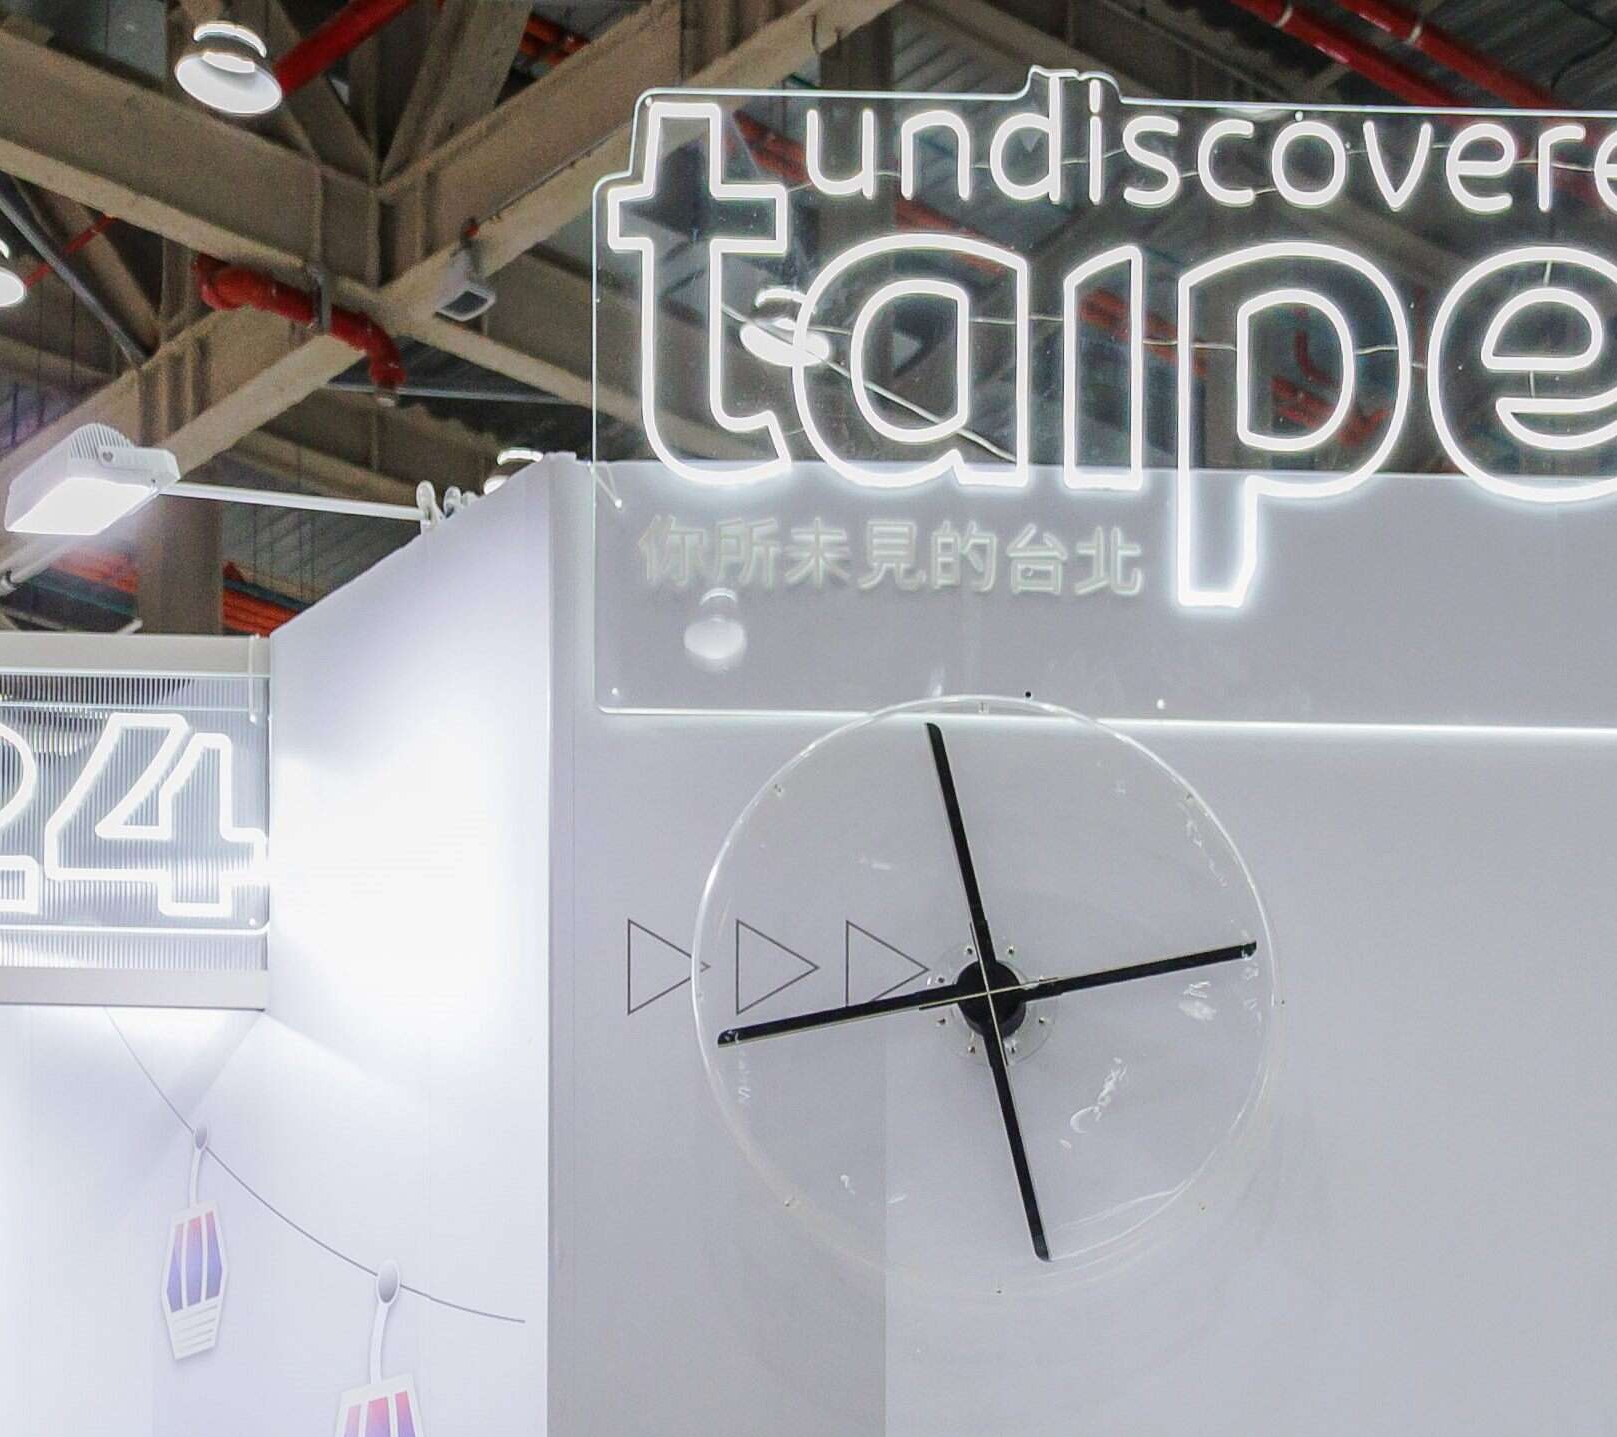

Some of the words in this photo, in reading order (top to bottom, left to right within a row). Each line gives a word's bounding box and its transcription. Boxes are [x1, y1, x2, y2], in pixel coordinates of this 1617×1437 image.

[637, 515, 1145, 597] 你所未見的台北
